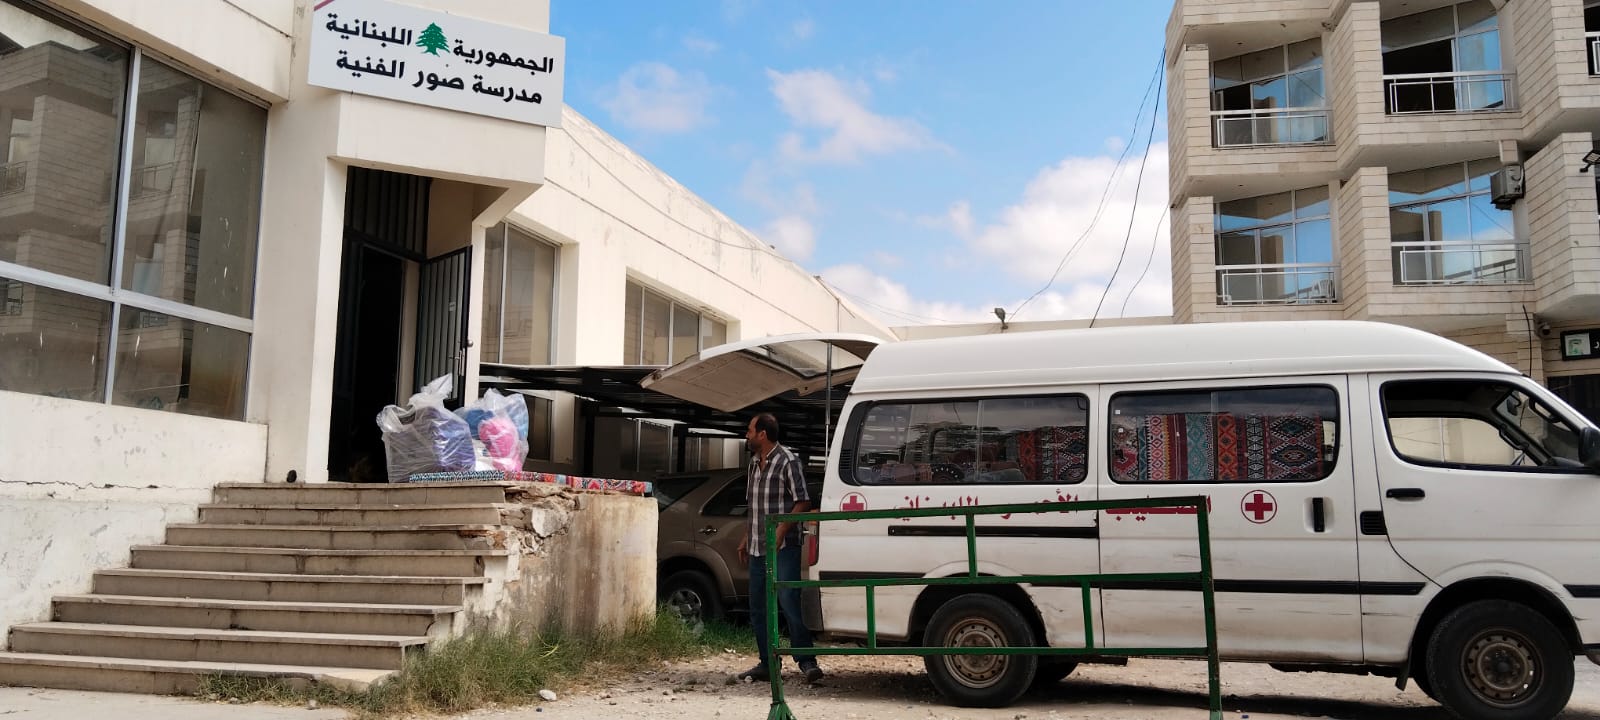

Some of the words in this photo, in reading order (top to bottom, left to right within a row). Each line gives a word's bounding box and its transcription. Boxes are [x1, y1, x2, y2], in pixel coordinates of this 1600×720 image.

[326, 13, 412, 48] اللبنانية
[336, 50, 405, 78] الفنية
[453, 39, 554, 75] الجمهورية
[412, 70, 465, 91] صور
[472, 74, 543, 104] مدرسة
